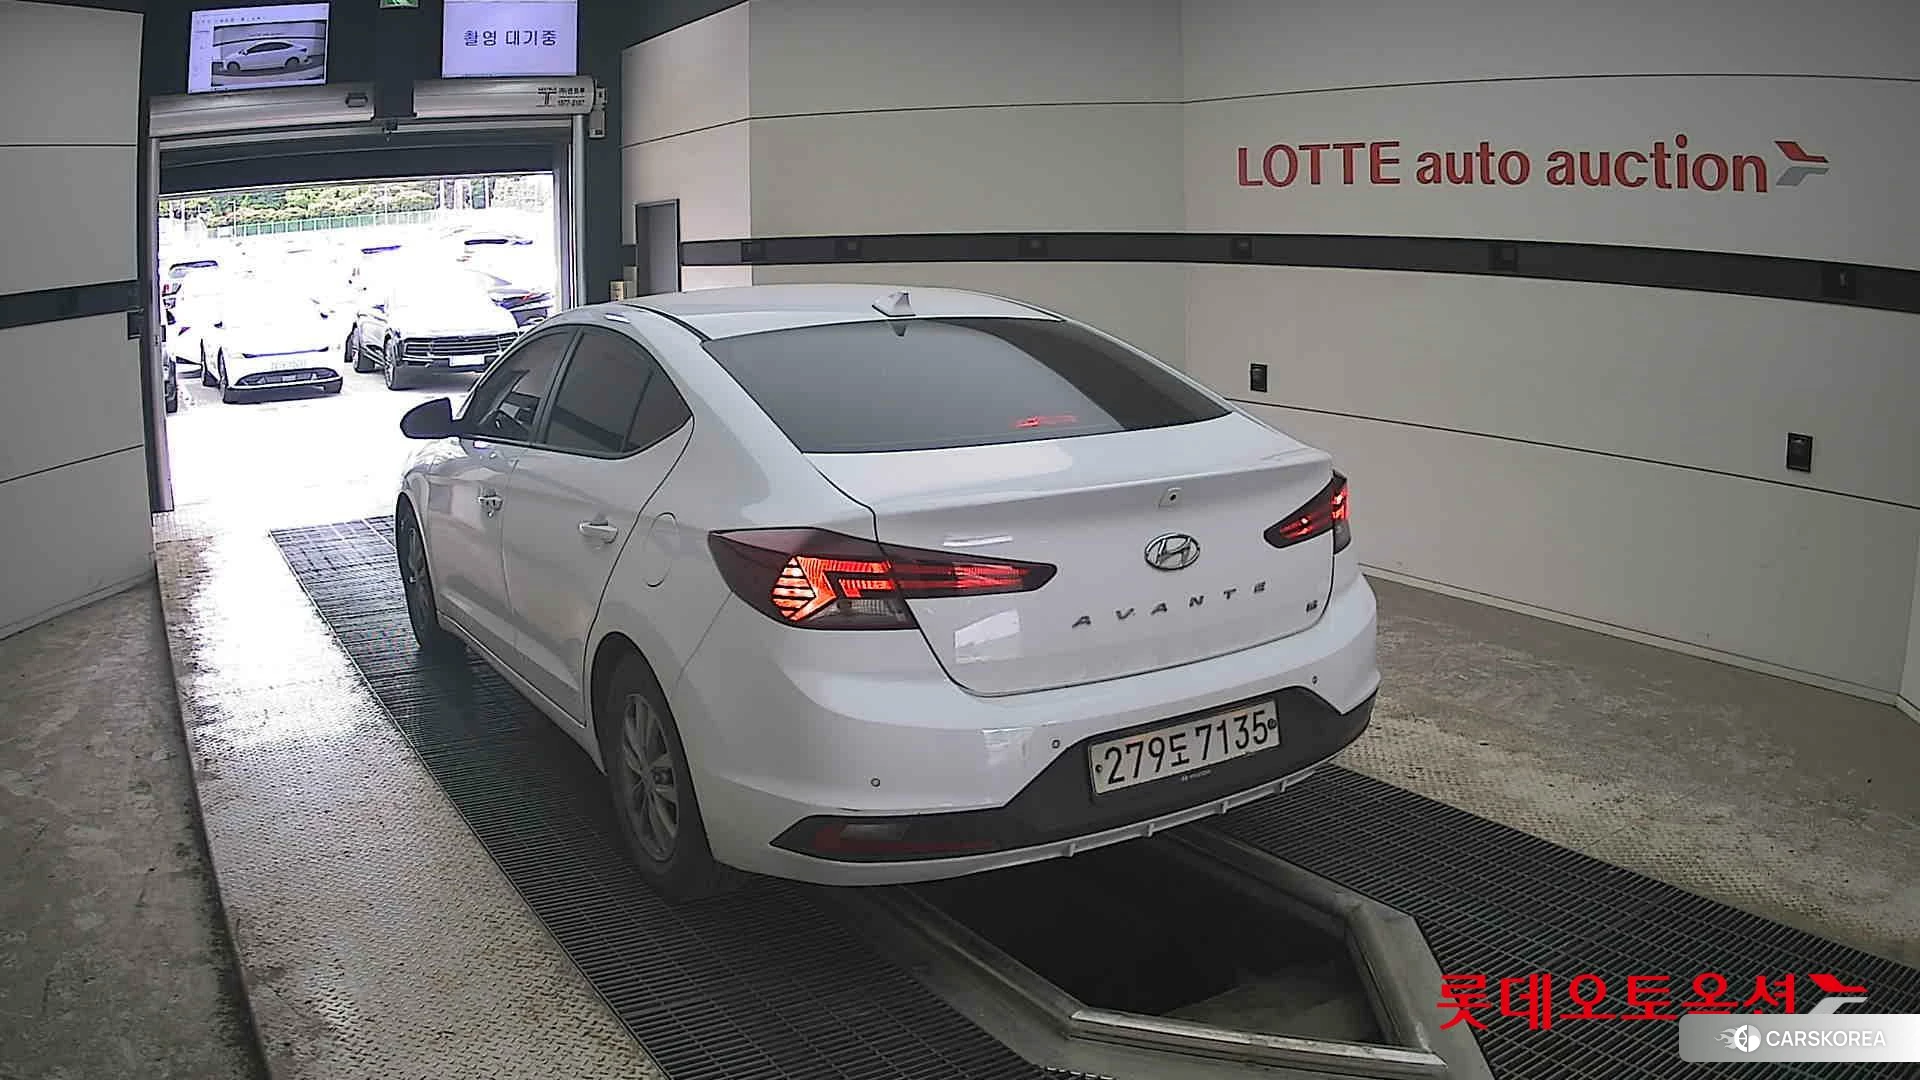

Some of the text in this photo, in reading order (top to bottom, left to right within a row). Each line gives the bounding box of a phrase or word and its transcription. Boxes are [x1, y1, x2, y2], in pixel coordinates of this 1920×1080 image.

[464, 30, 556, 46] 촬영 대기중
[1238, 134, 1768, 193] LOTTE auto auction
[1072, 581, 1266, 628] AVANTE
